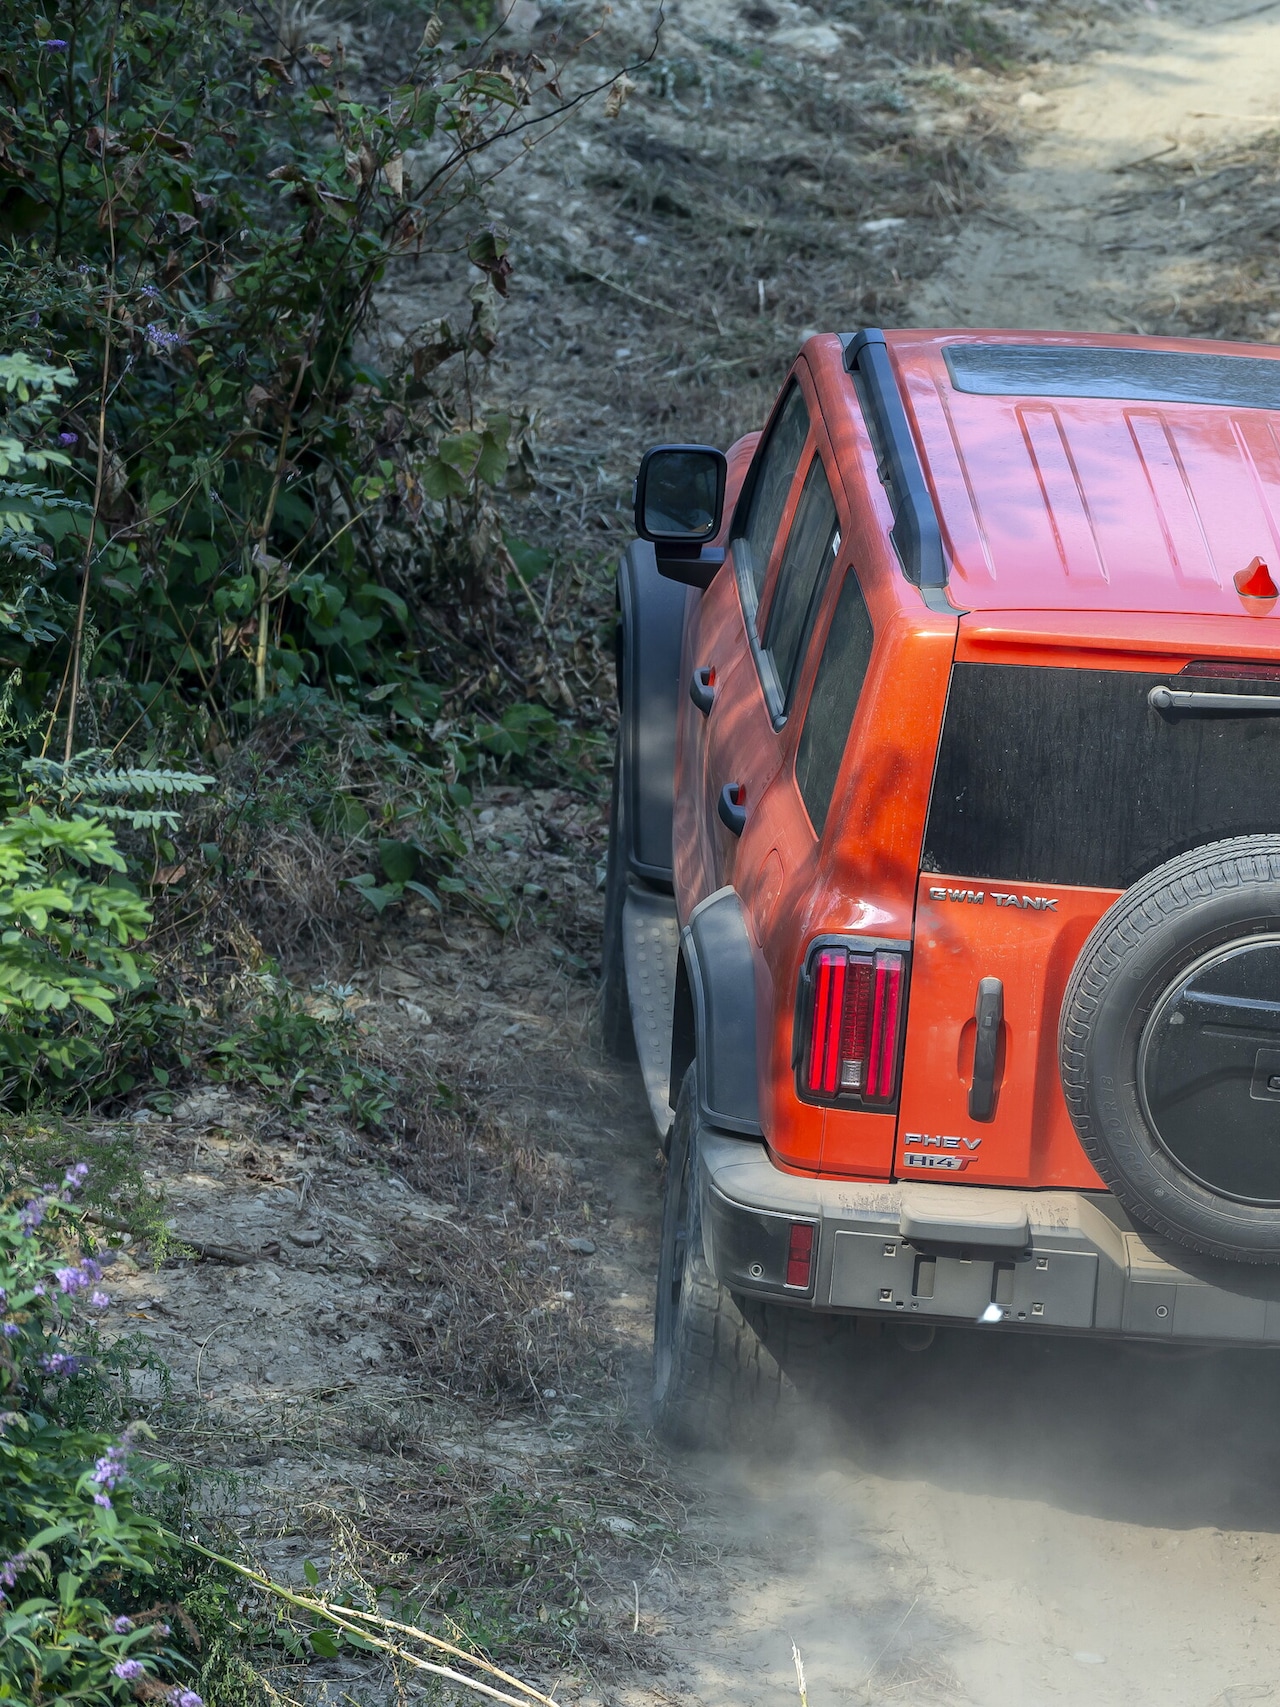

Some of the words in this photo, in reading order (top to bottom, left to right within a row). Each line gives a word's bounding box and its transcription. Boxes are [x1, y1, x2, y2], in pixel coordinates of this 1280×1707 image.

[929, 887, 985, 905] GWM
[989, 892, 1060, 913] TANK
[903, 1132, 983, 1151] PHEV
